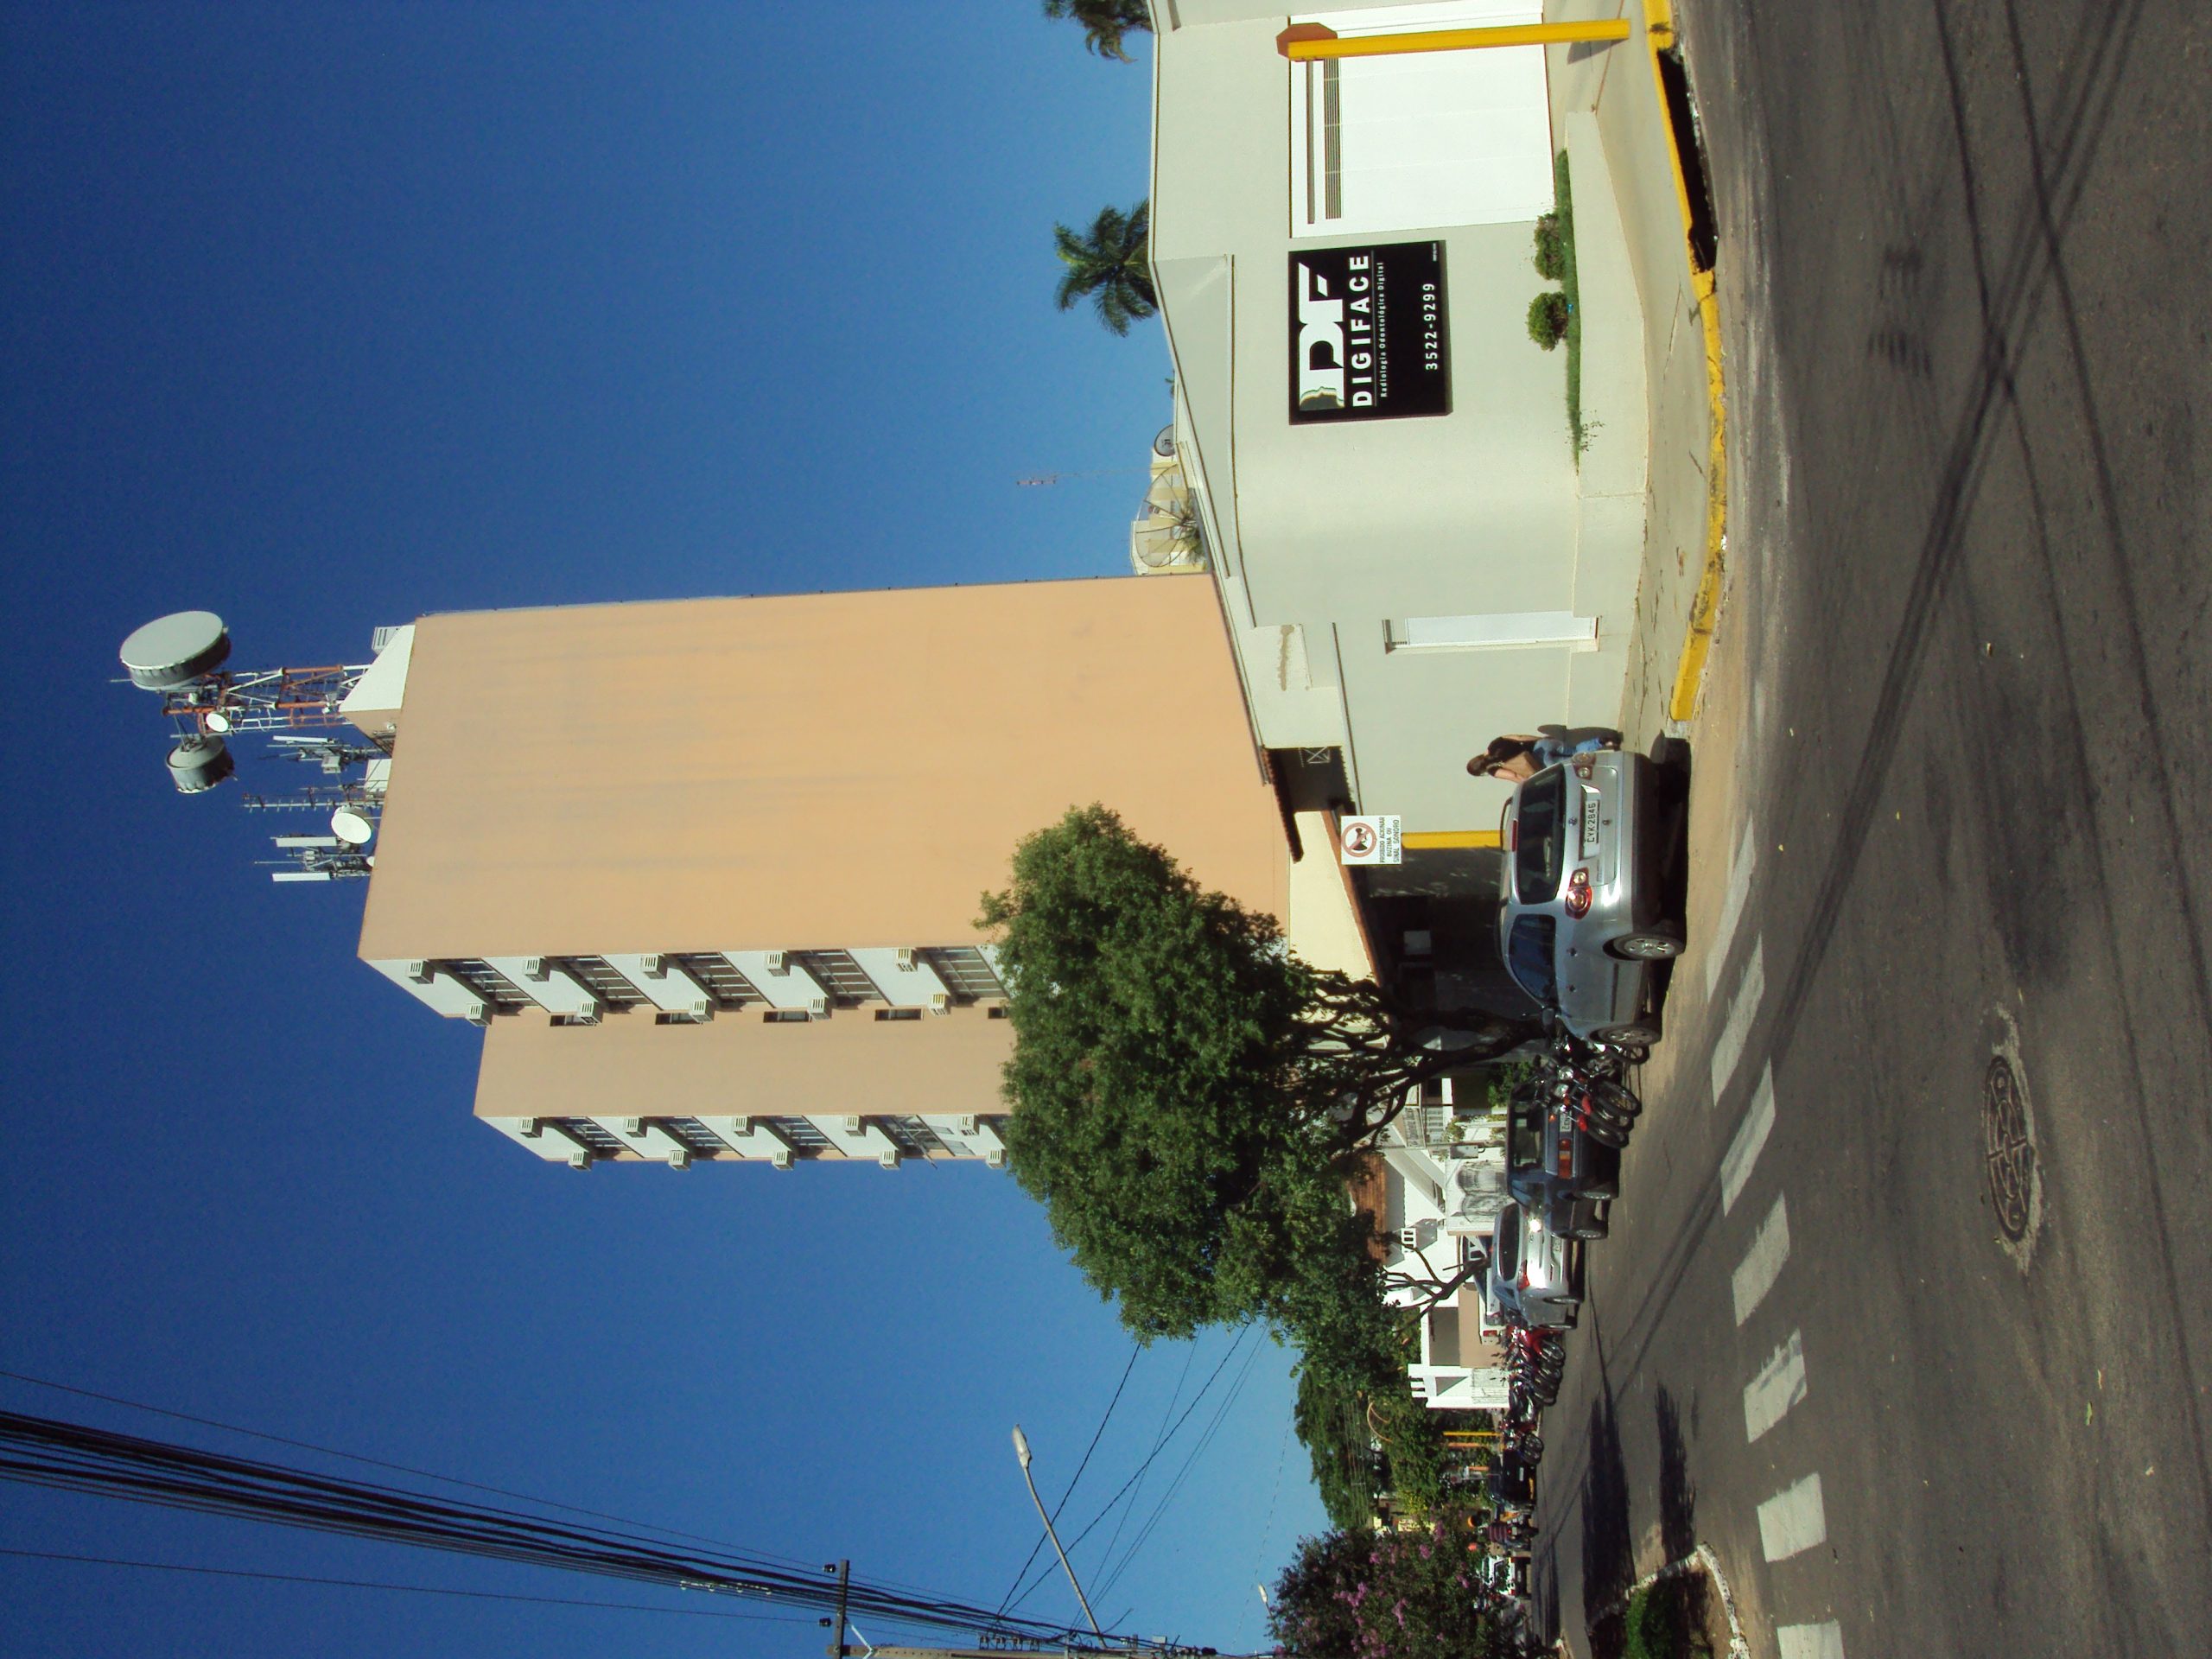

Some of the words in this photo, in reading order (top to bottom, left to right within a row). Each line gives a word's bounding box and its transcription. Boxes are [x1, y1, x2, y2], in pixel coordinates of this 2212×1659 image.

[1376, 262, 1385, 290] Digital
[1350, 255, 1372, 407] DIGIFACE
[1377, 293, 1387, 349] Odontológica
[1422, 283, 1438, 370] 3522-9299
[1379, 352, 1388, 397] Radiologia
